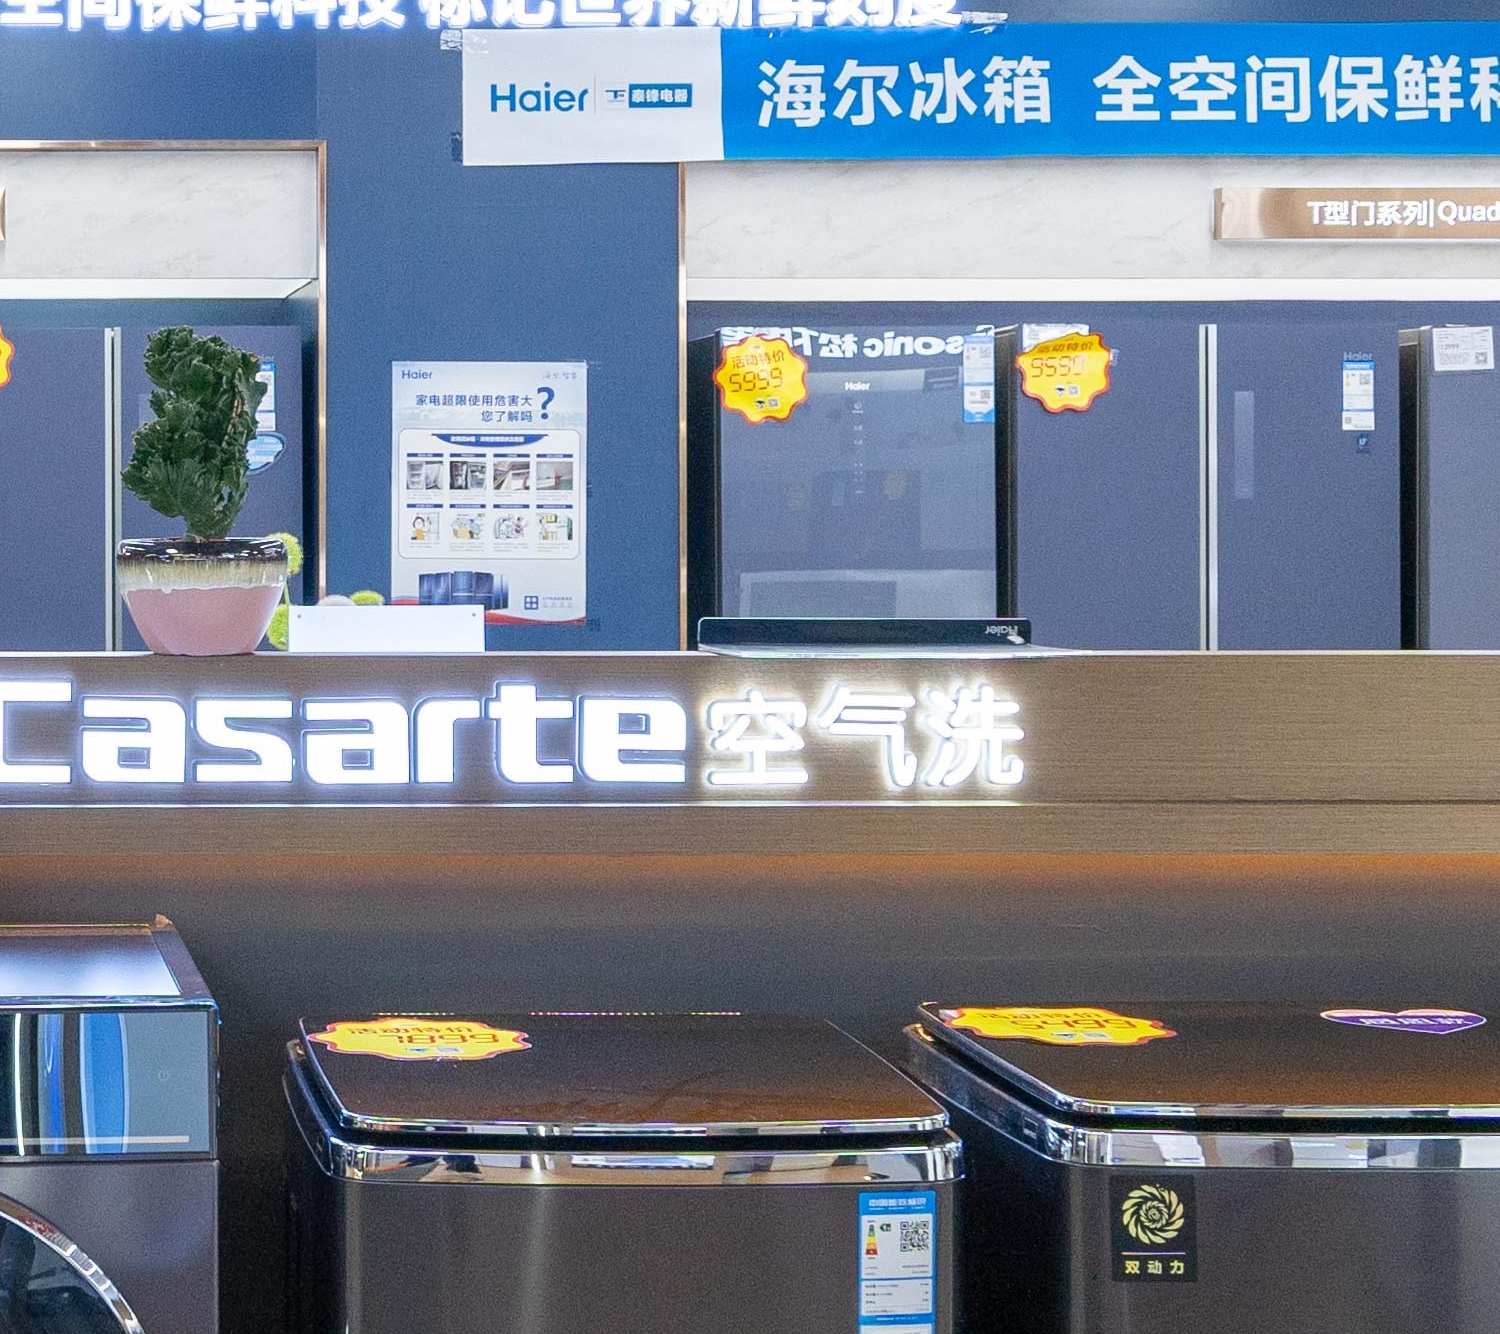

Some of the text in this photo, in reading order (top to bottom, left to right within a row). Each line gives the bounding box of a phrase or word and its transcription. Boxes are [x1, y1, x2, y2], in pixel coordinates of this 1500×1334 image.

[490, 81, 589, 114] Haier
[630, 85, 692, 107] 泰锋电器
[758, 55, 1053, 130] 海尔冰箱
[731, 349, 785, 370] 活动特价
[1344, 352, 1373, 361] Haier
[401, 370, 432, 379] Haier
[845, 381, 870, 392] Haier
[416, 394, 533, 407] 家电超限使用危害大
[481, 411, 533, 423] 您了解吗
[703, 684, 1026, 789] 空气洗
[1124, 1259, 1185, 1276] 双动力
